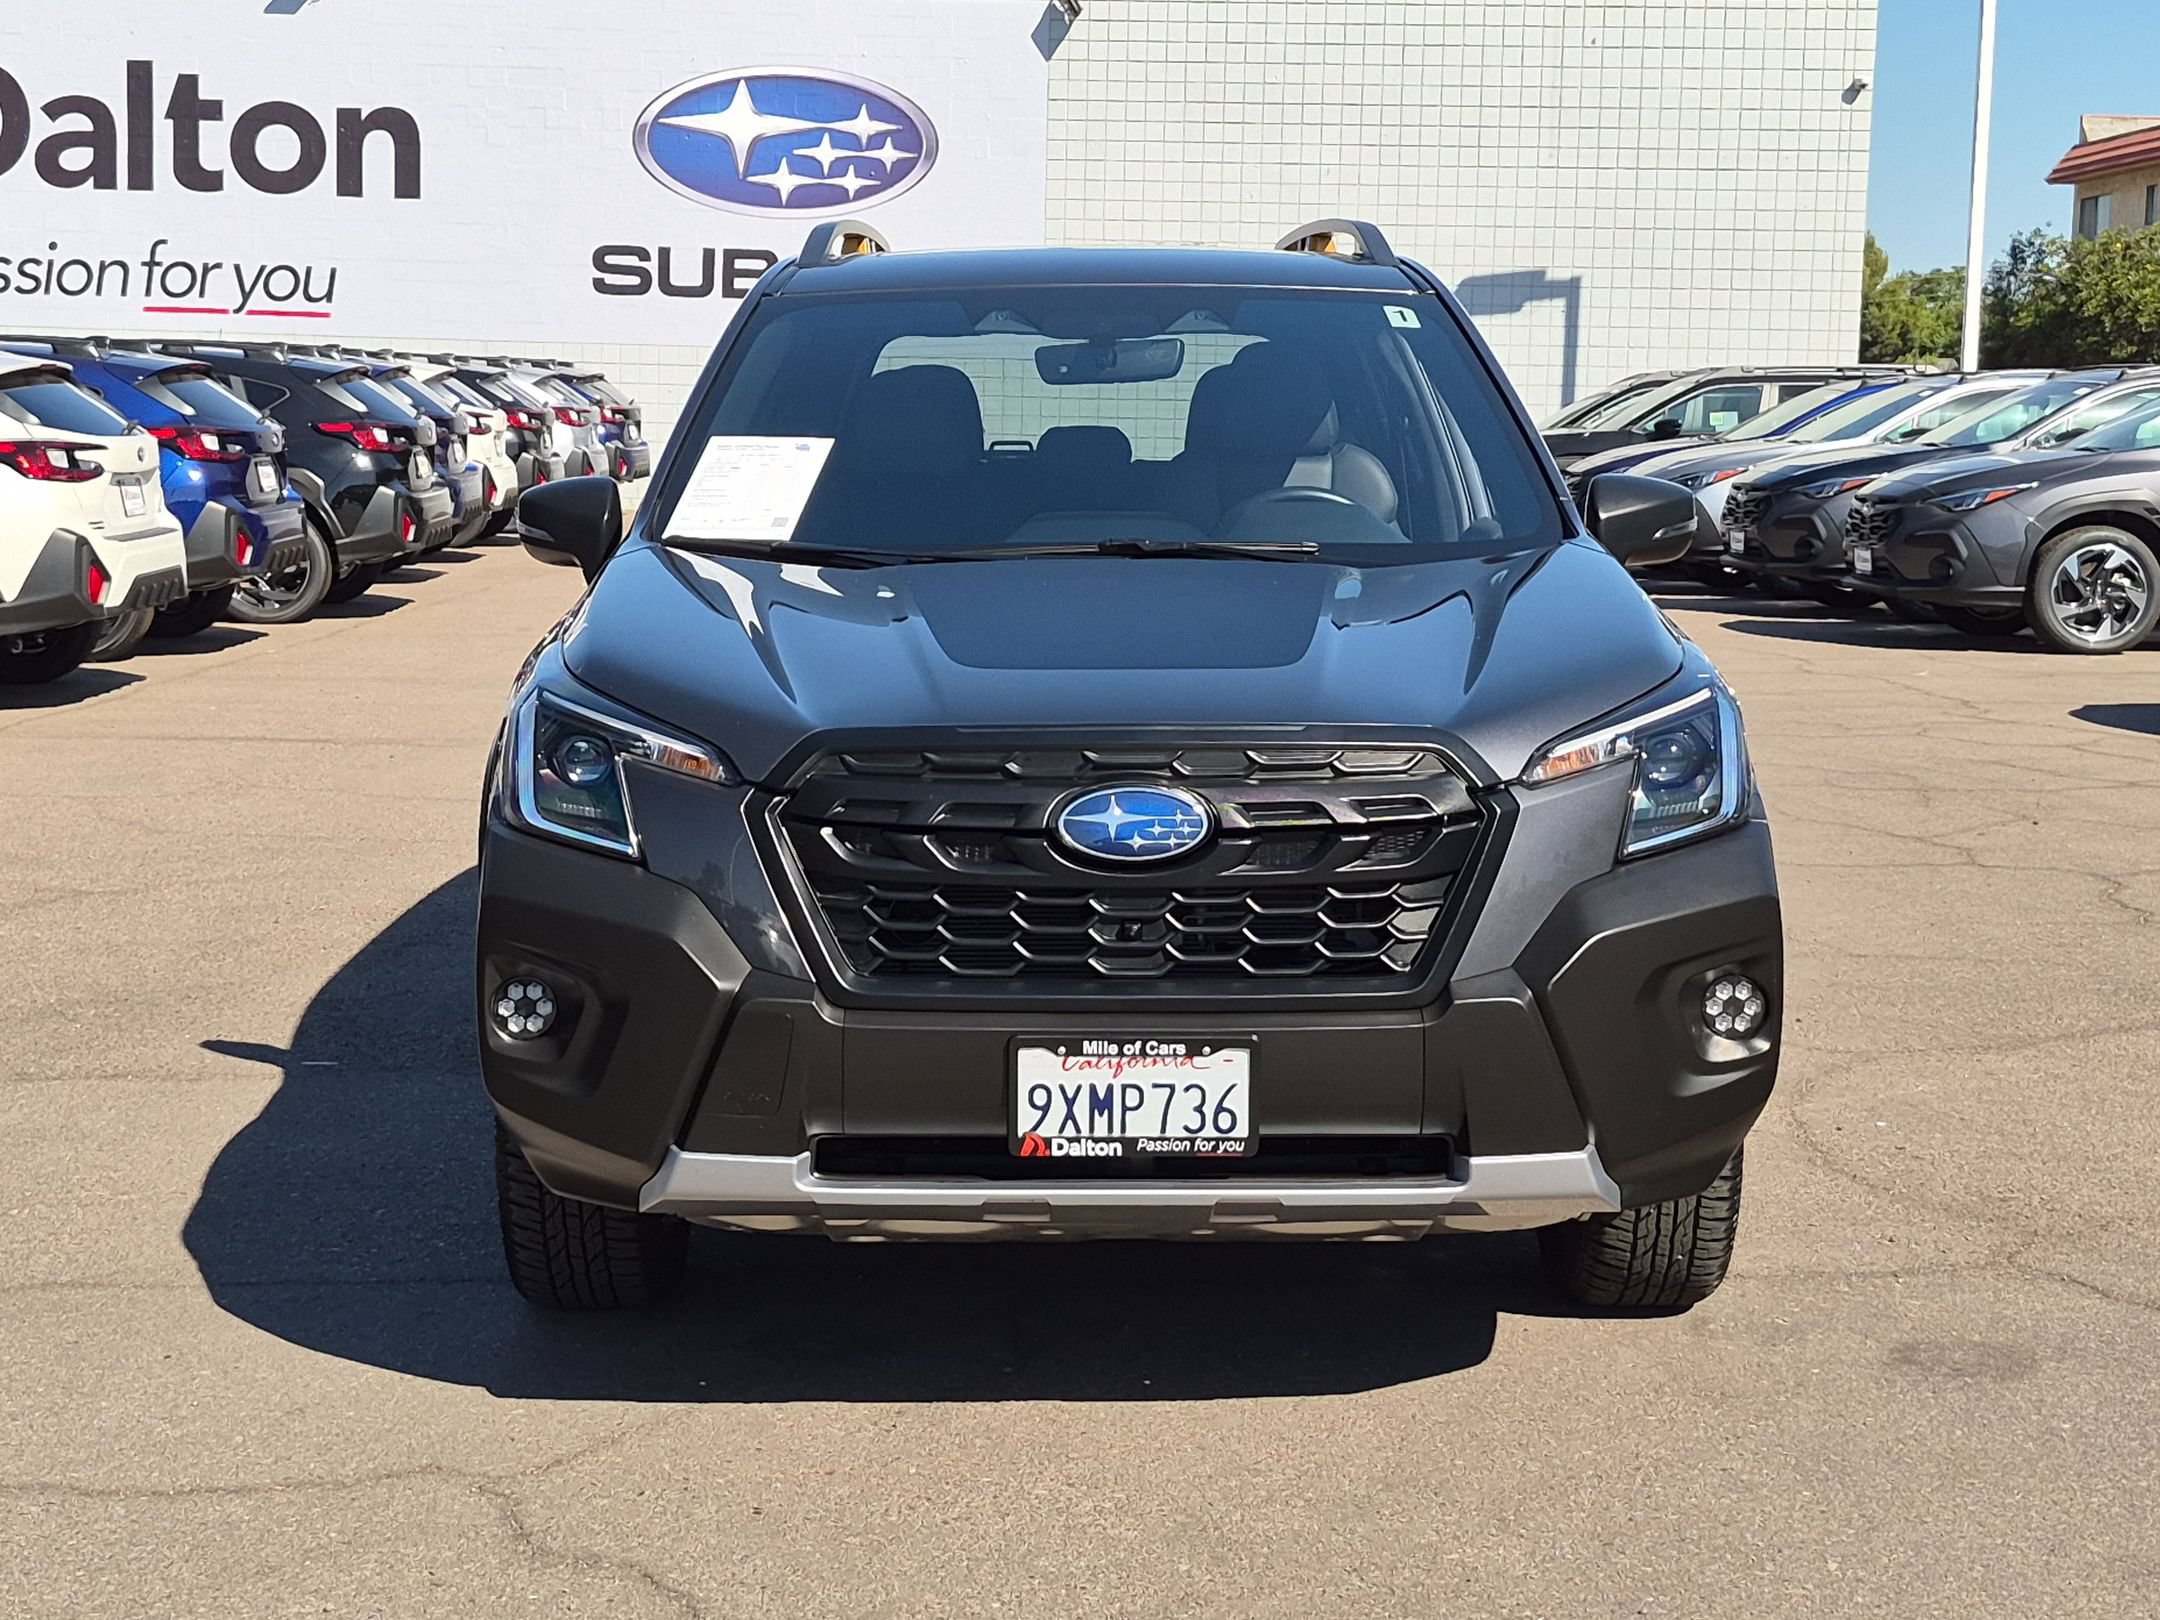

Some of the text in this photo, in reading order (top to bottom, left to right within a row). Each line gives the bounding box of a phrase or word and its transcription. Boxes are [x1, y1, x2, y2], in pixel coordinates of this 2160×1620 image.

[143, 239, 223, 299] for
[232, 261, 337, 315] you
[1082, 1040, 1187, 1056] Mile of Cars
[1027, 1082, 1239, 1135] 9XMP736
[1051, 1137, 1123, 1157] Dalton
[1136, 1137, 1245, 1154] Passion for you
